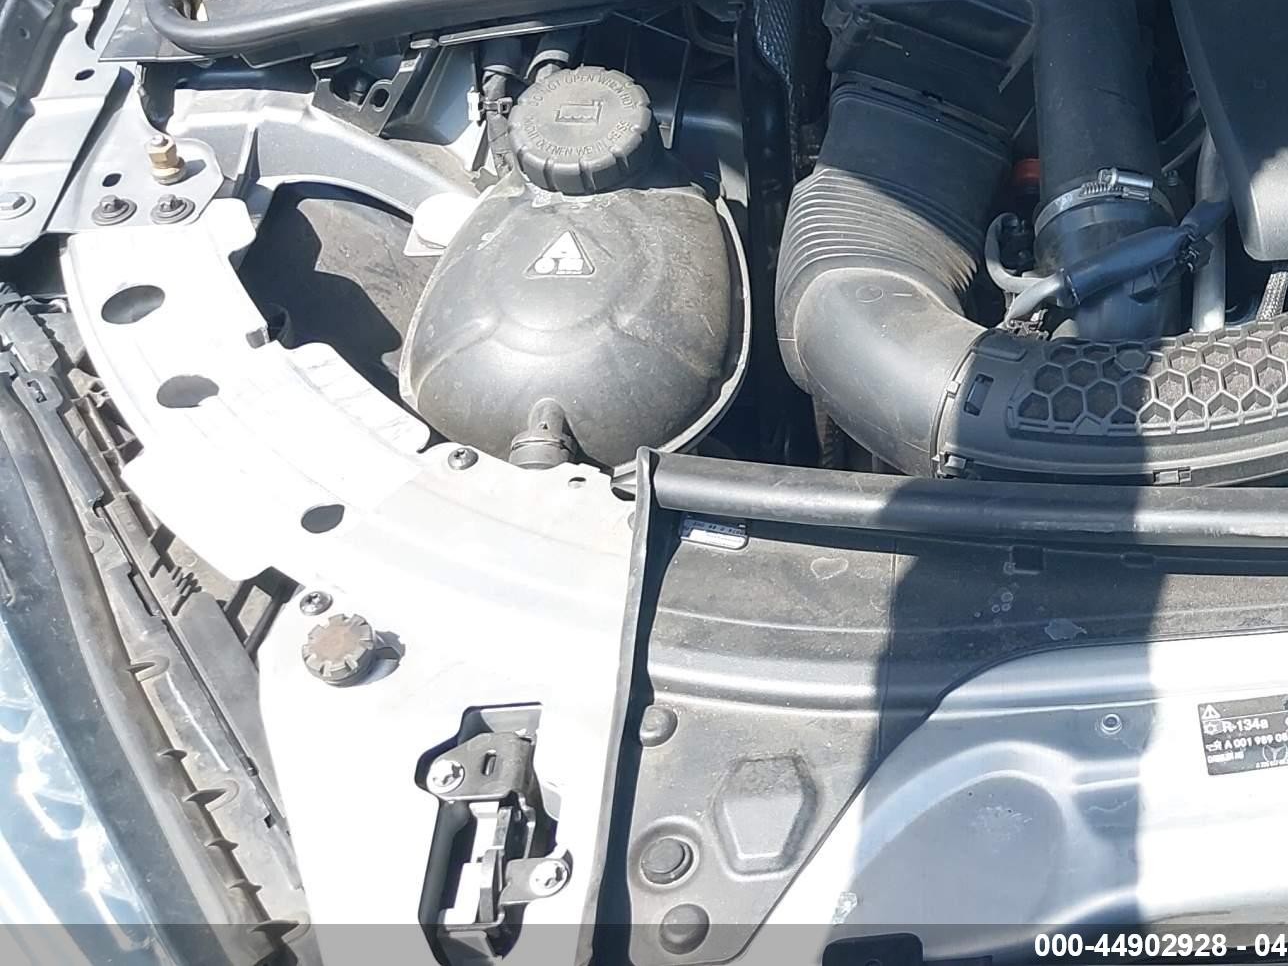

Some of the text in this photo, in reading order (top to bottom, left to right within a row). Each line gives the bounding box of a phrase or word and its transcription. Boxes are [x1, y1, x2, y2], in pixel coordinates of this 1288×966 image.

[564, 73, 594, 84] OPEN
[597, 75, 622, 94] WHEN
[1222, 718, 1269, 733] R-134a
[1225, 740, 1232, 750] A
[1233, 737, 1252, 748] 001
